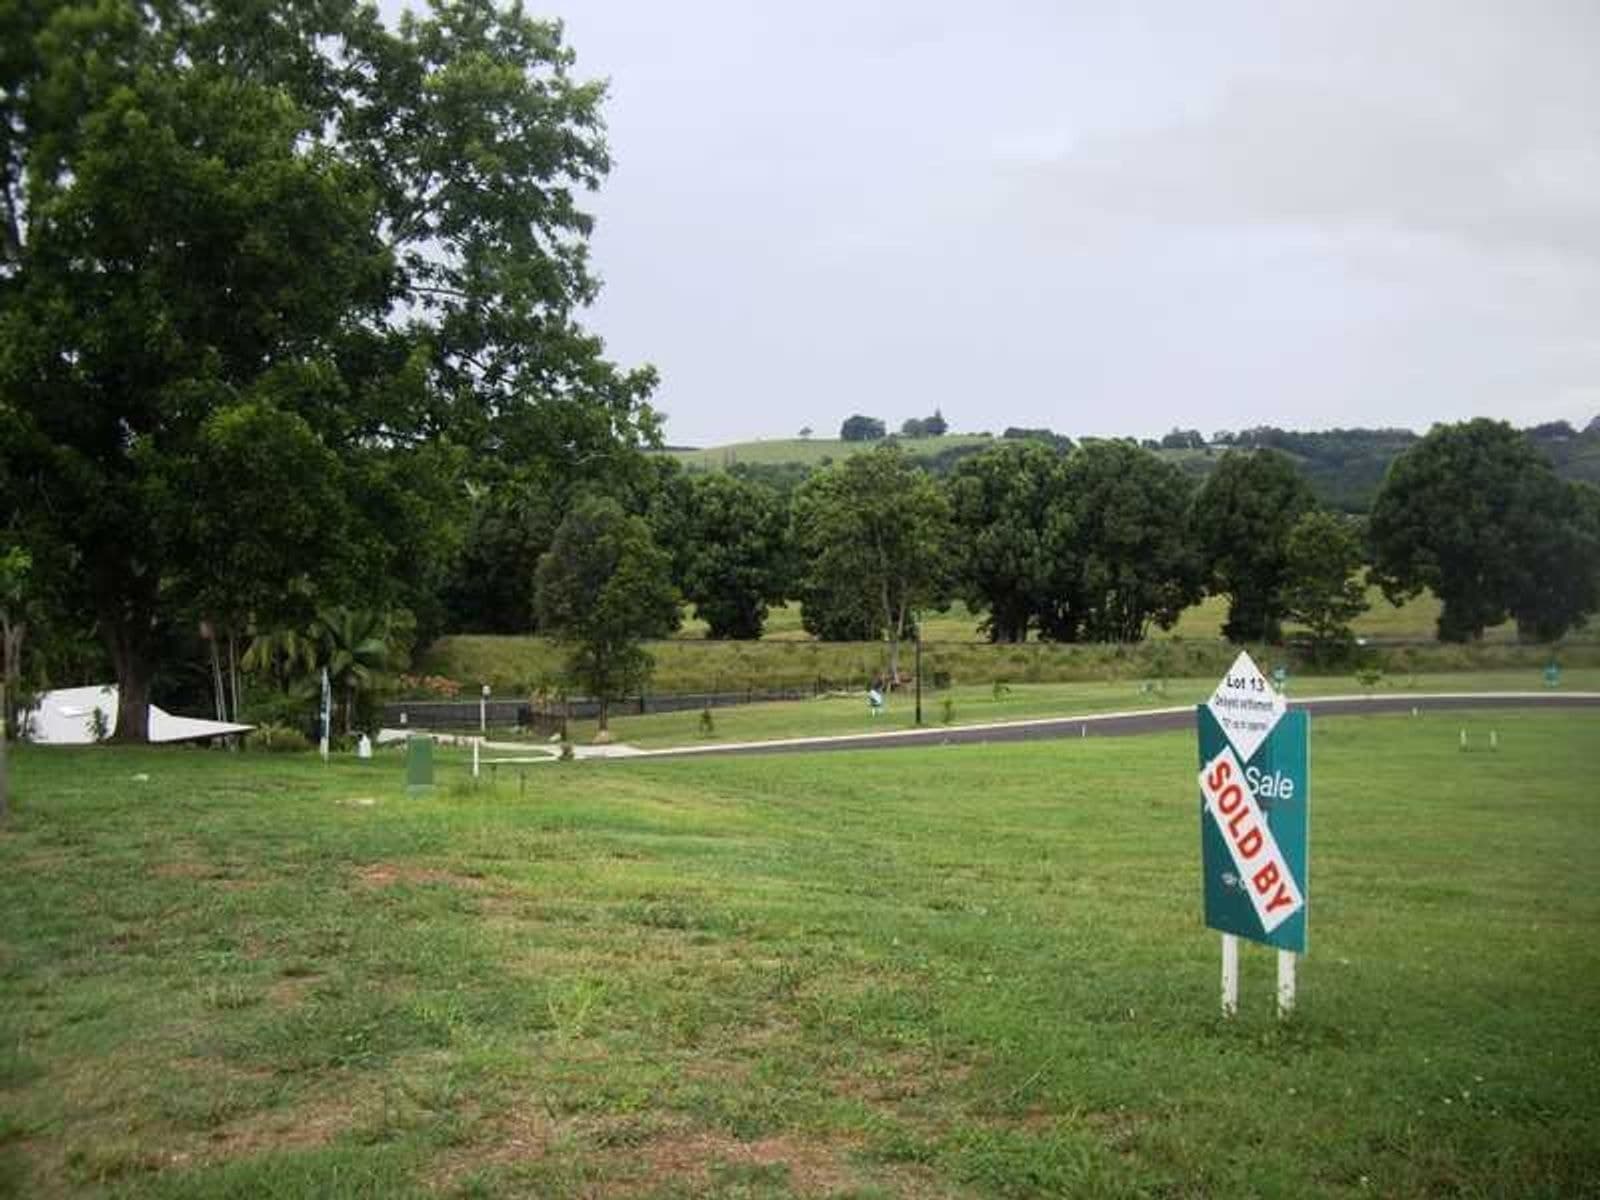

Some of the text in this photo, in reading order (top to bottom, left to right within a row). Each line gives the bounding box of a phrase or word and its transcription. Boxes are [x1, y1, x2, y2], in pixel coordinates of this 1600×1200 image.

[1227, 675, 1265, 692] Lot 13
[1245, 766, 1294, 799] Sale
[1208, 761, 1263, 859] SOLD
[1252, 861, 1292, 912] BY
